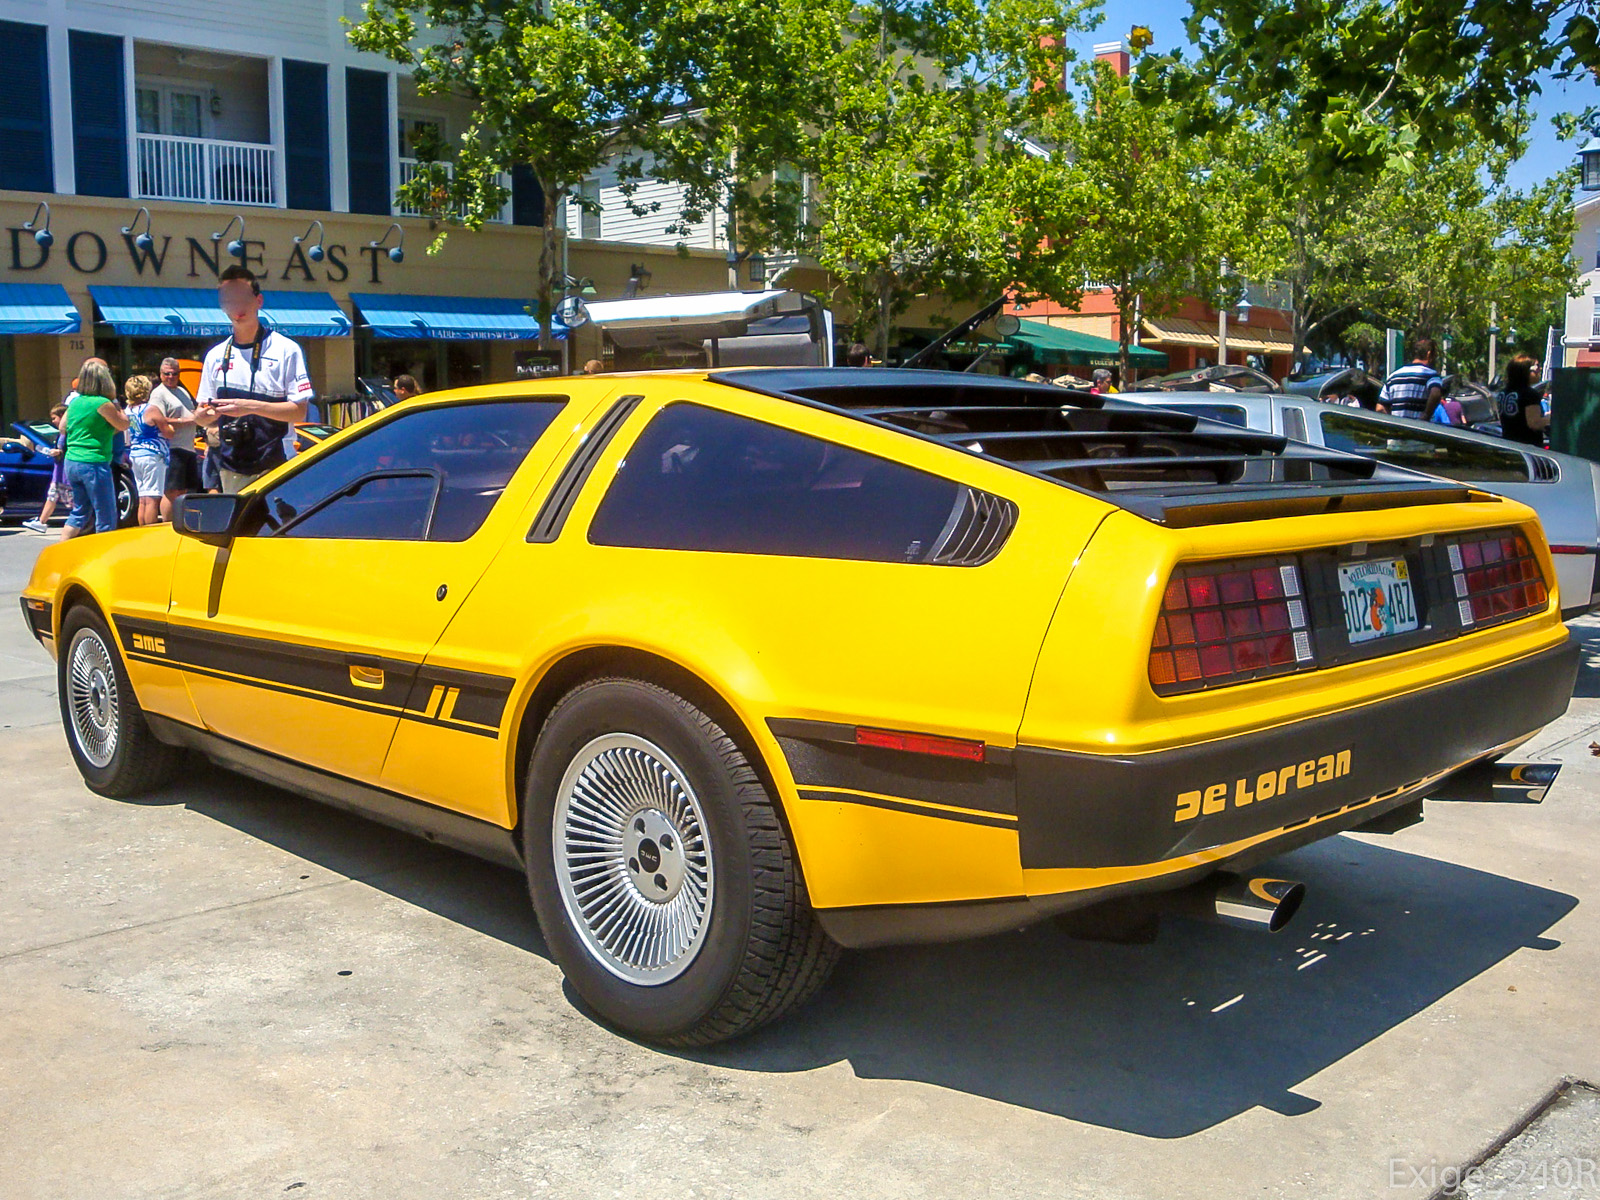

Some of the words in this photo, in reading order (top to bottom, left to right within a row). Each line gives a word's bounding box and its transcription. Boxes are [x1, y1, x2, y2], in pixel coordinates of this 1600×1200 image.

[6, 228, 392, 283] DOWNEAST
[181, 325, 212, 335] GIFTS
[466, 331, 520, 339] SPORTSWEAR
[516, 365, 560, 373] NAPLES
